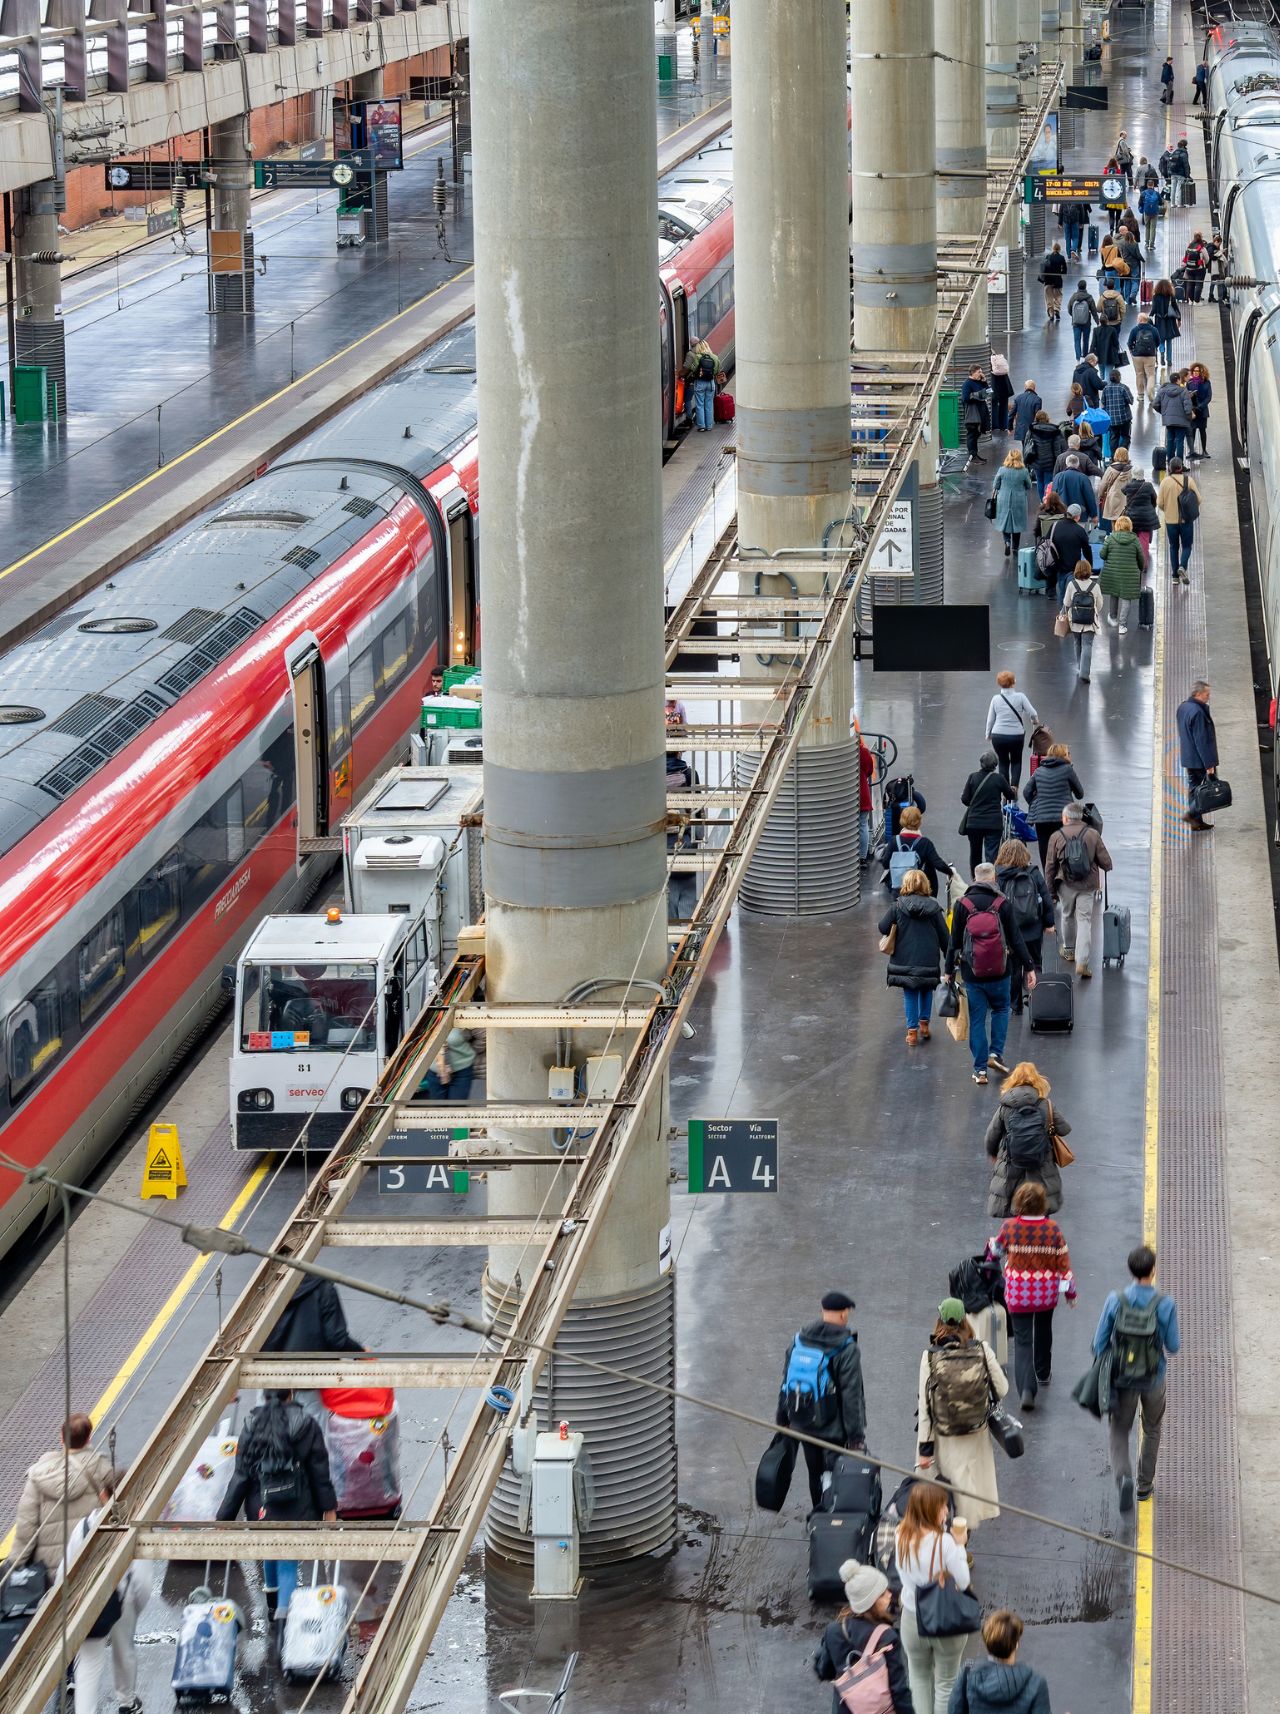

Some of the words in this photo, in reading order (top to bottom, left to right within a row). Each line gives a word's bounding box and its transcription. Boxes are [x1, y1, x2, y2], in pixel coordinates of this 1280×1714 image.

[189, 173, 198, 186] 1
[265, 173, 273, 185] 2
[1034, 187, 1043, 200] 4
[298, 1064, 312, 1073] 81
[289, 1088, 325, 1097] serveo
[708, 1124, 733, 1132] Sector
[749, 1123, 762, 1132] Vía
[386, 1165, 405, 1189] 3
[425, 1165, 450, 1189] A
[708, 1155, 732, 1188] A
[751, 1155, 775, 1188] 4
